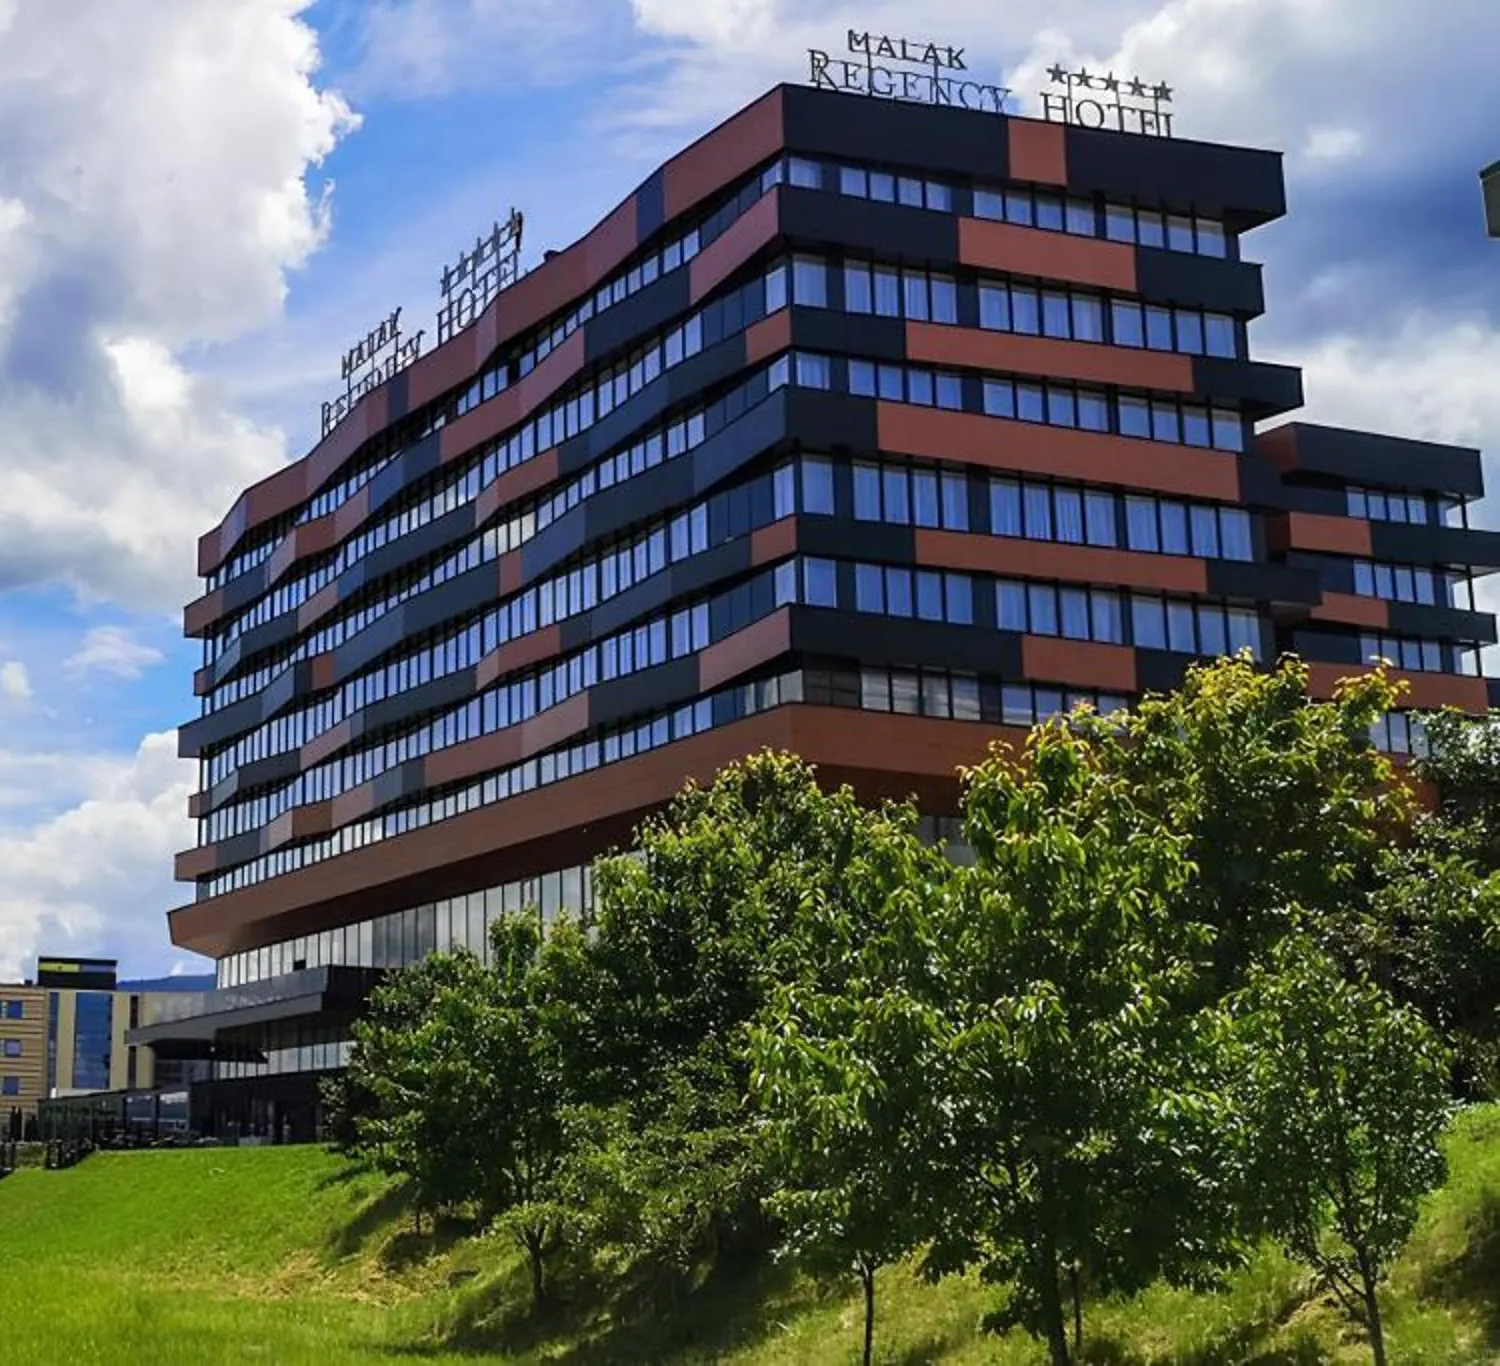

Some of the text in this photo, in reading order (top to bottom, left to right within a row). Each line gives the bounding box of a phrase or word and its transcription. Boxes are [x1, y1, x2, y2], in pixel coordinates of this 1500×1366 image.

[847, 29, 967, 70] MALAK
[807, 49, 1172, 137] REGENCY HOTEL
[342, 306, 402, 380] MALAK
